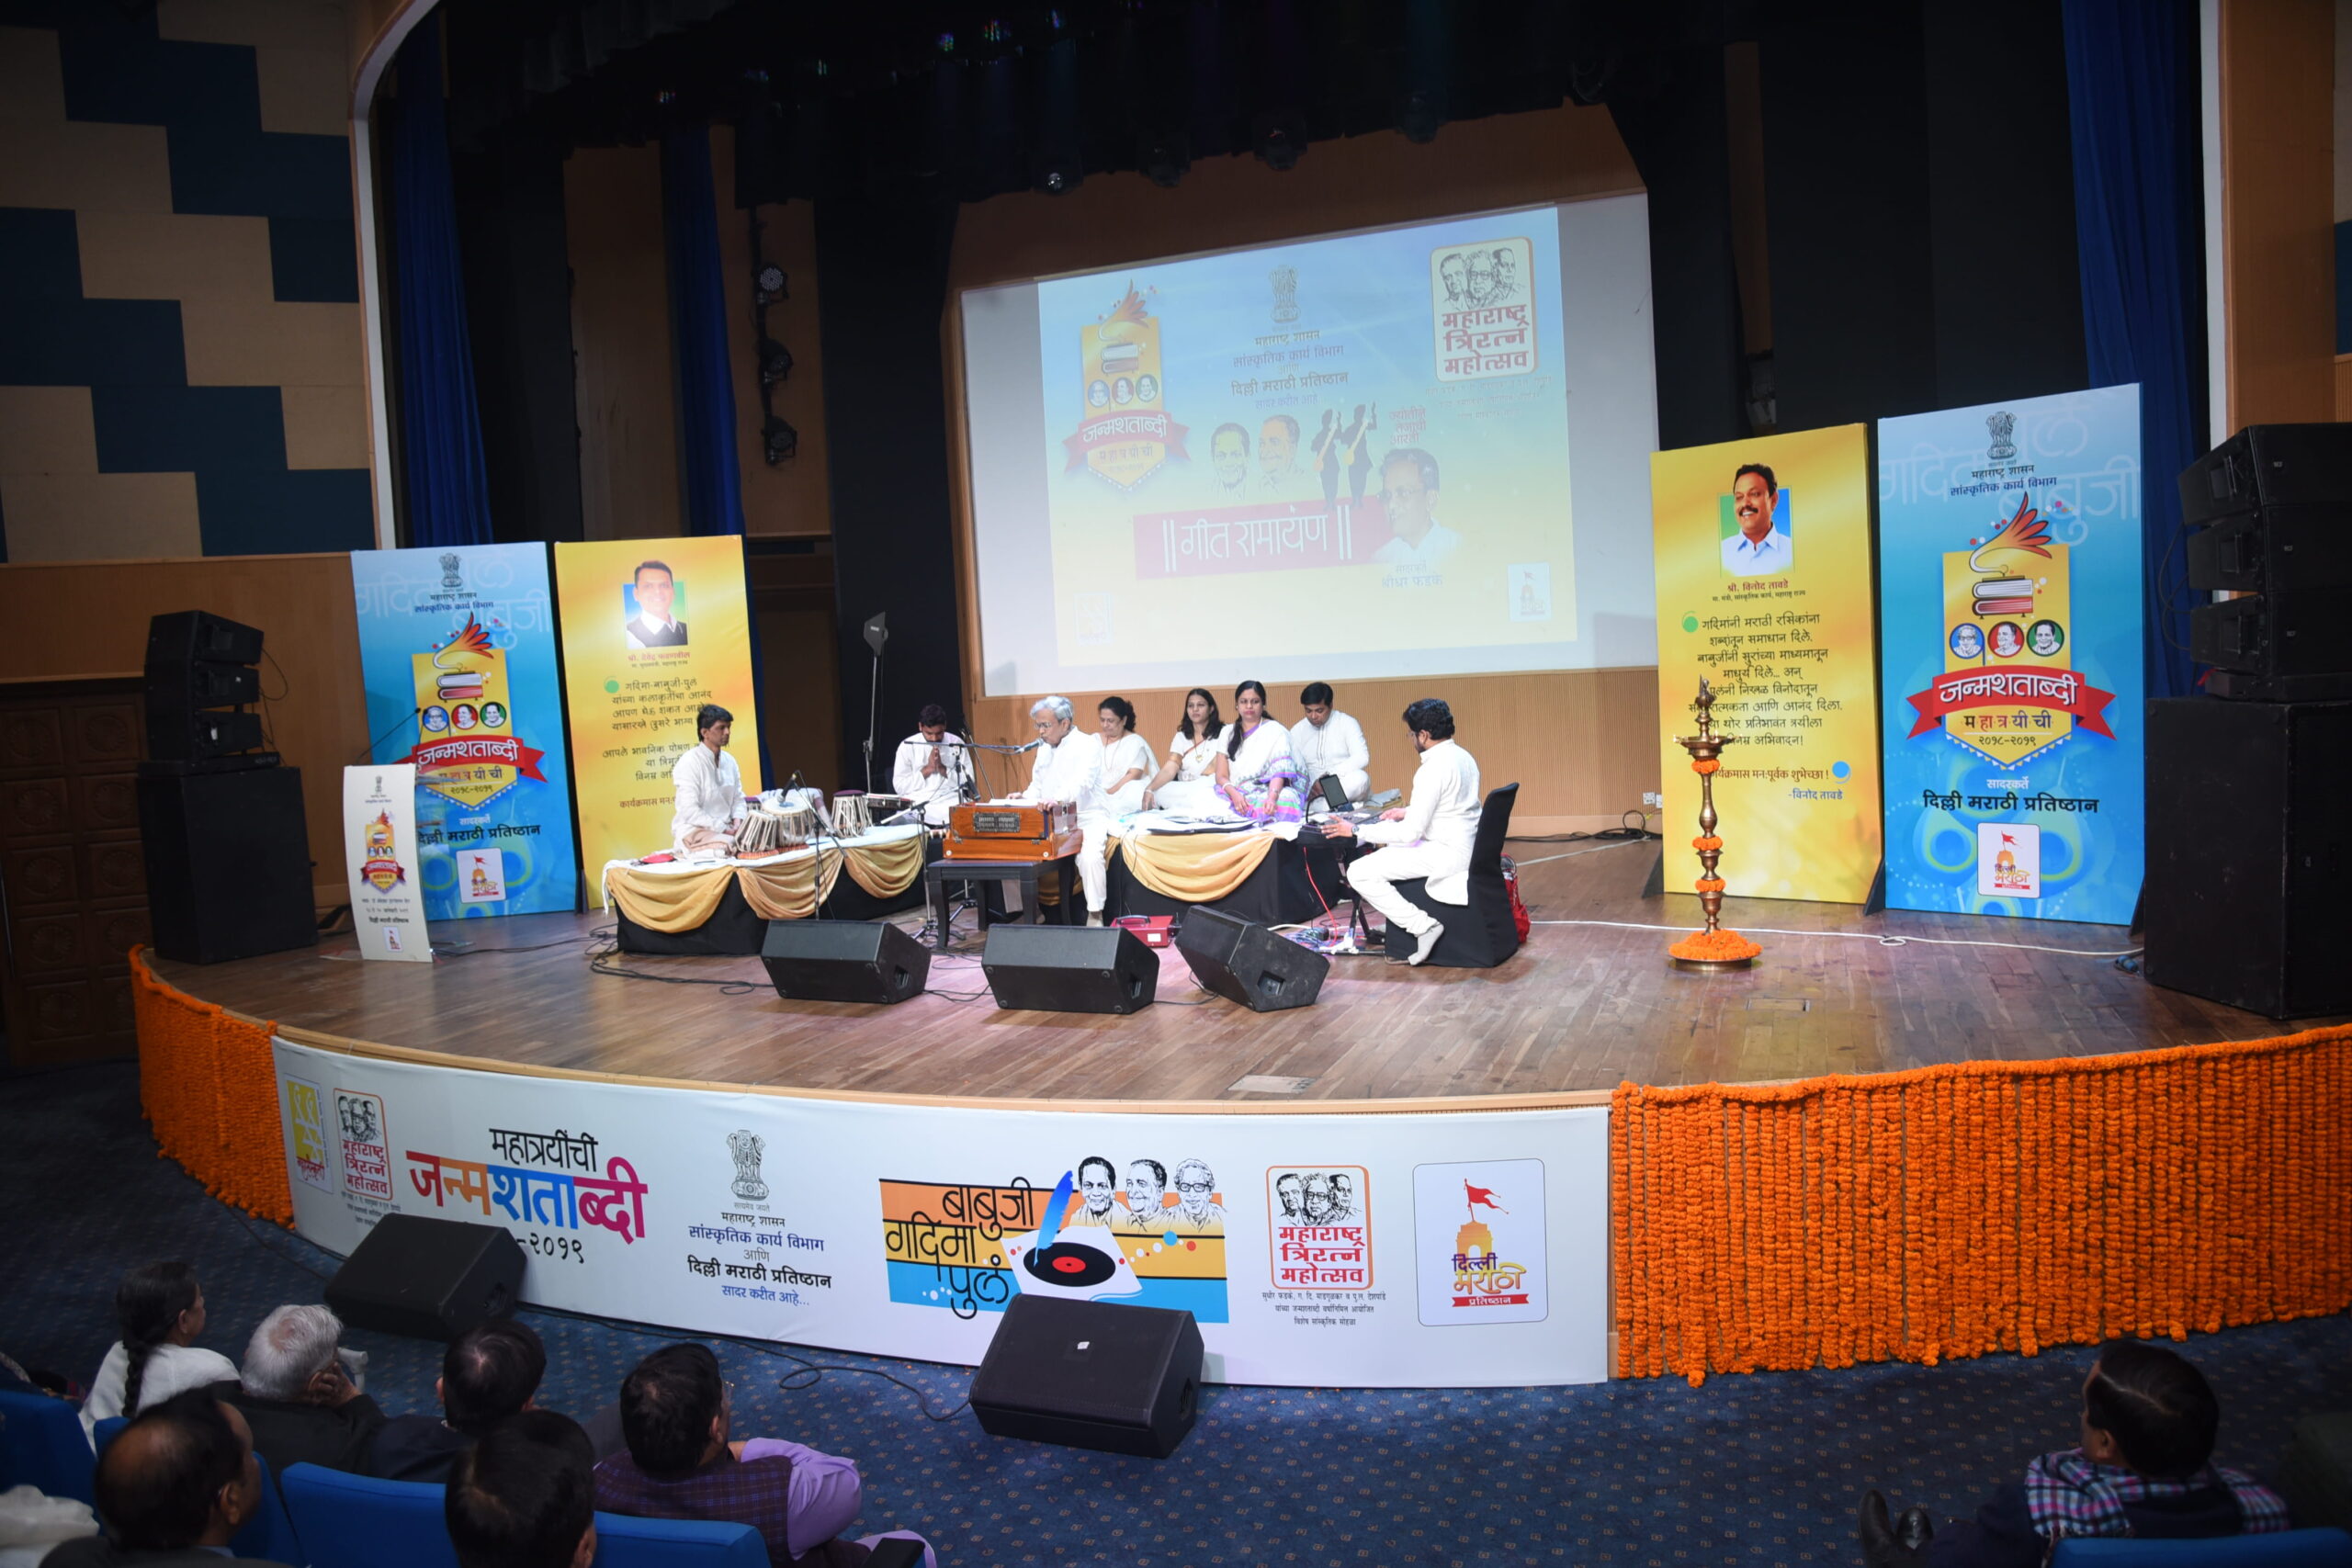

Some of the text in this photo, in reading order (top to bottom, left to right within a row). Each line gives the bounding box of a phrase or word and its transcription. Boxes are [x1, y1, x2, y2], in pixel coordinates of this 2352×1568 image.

[1442, 304, 1530, 329] महाराष्ट्र
[1442, 327, 1528, 352] त्रिरत्न
[1315, 344, 1343, 357] विभाग
[1443, 349, 1529, 375] महोत्सव
[1262, 374, 1296, 391] मराठी
[1300, 371, 1349, 388] प्रतिष्ठान
[1082, 414, 1167, 443] जन्मशताब्दी
[1972, 465, 2035, 479] महाराष्ट्र शासन
[1951, 477, 2057, 497] सांस्कृतिक कार्य विभाग
[1181, 518, 1230, 559] गीत
[1743, 581, 1765, 592] विनोद
[1769, 579, 1789, 591] तावडे
[1702, 611, 1820, 630] गदिमांनी मराठी रसिकांना
[1748, 633, 1786, 644] समाधान
[1791, 628, 1813, 643] दिले.
[1742, 649, 1775, 666] सुरांच्या
[1780, 649, 1828, 662] माध्यमातून
[1723, 666, 1750, 682] माधुर्य
[1784, 667, 1803, 680] अन्
[1773, 682, 1817, 697] विनोदातून
[1939, 673, 2078, 705] जन्मशताब्दी
[613, 708, 638, 717] आपण
[659, 705, 680, 715] शकत
[1689, 697, 1842, 713] सरात्मकता आणि आनंद दिला.
[1723, 716, 1741, 728] थोर
[1746, 716, 1786, 728] प्रतिभावंत
[1755, 733, 1804, 746] अभिवादन!
[1979, 736, 2036, 746] २०१८-२०१९
[417, 739, 519, 764] जन्मशताब्दी
[603, 746, 628, 758] आपले
[632, 743, 664, 755] भावनिक
[645, 759, 655, 768] या
[1713, 766, 1749, 779] ार्यक्रमास
[1986, 776, 2029, 789] सादरकर्ते
[619, 797, 658, 808] कार्यक्रमास
[1820, 789, 1843, 800] तावडे
[1923, 790, 2099, 813] दिल्ली मराठी प्रतिष्ठान
[447, 825, 484, 841] मराठी
[489, 824, 541, 838] प्रतिष्ठान
[343, 1139, 386, 1164] महाराष्ट्र
[489, 1128, 598, 1172] महात्रयींची
[345, 1153, 386, 1177] त्रिरत्न
[346, 1171, 388, 1194] महोत्सव
[406, 1150, 649, 1245] जन्मशताब्दी
[721, 1212, 786, 1227] महाराष्ट्र शासन
[688, 1224, 824, 1251] सांस्कृतिक कार्य विभाग
[1278, 1227, 1365, 1247] महाराष्ट्र
[743, 1247, 770, 1262] आणि
[1279, 1242, 1363, 1262] त्रिरत्न
[1451, 1252, 1498, 1272] दिल्ली
[687, 1254, 831, 1289] दिल्ली मराठी प्रतिष्ठान
[1281, 1262, 1364, 1284] महोत्सव
[1453, 1262, 1527, 1294] मराठी
[721, 1285, 747, 1298] सादर
[749, 1286, 776, 1301] करीत
[1469, 1296, 1511, 1306] प्रतिष्ठान
